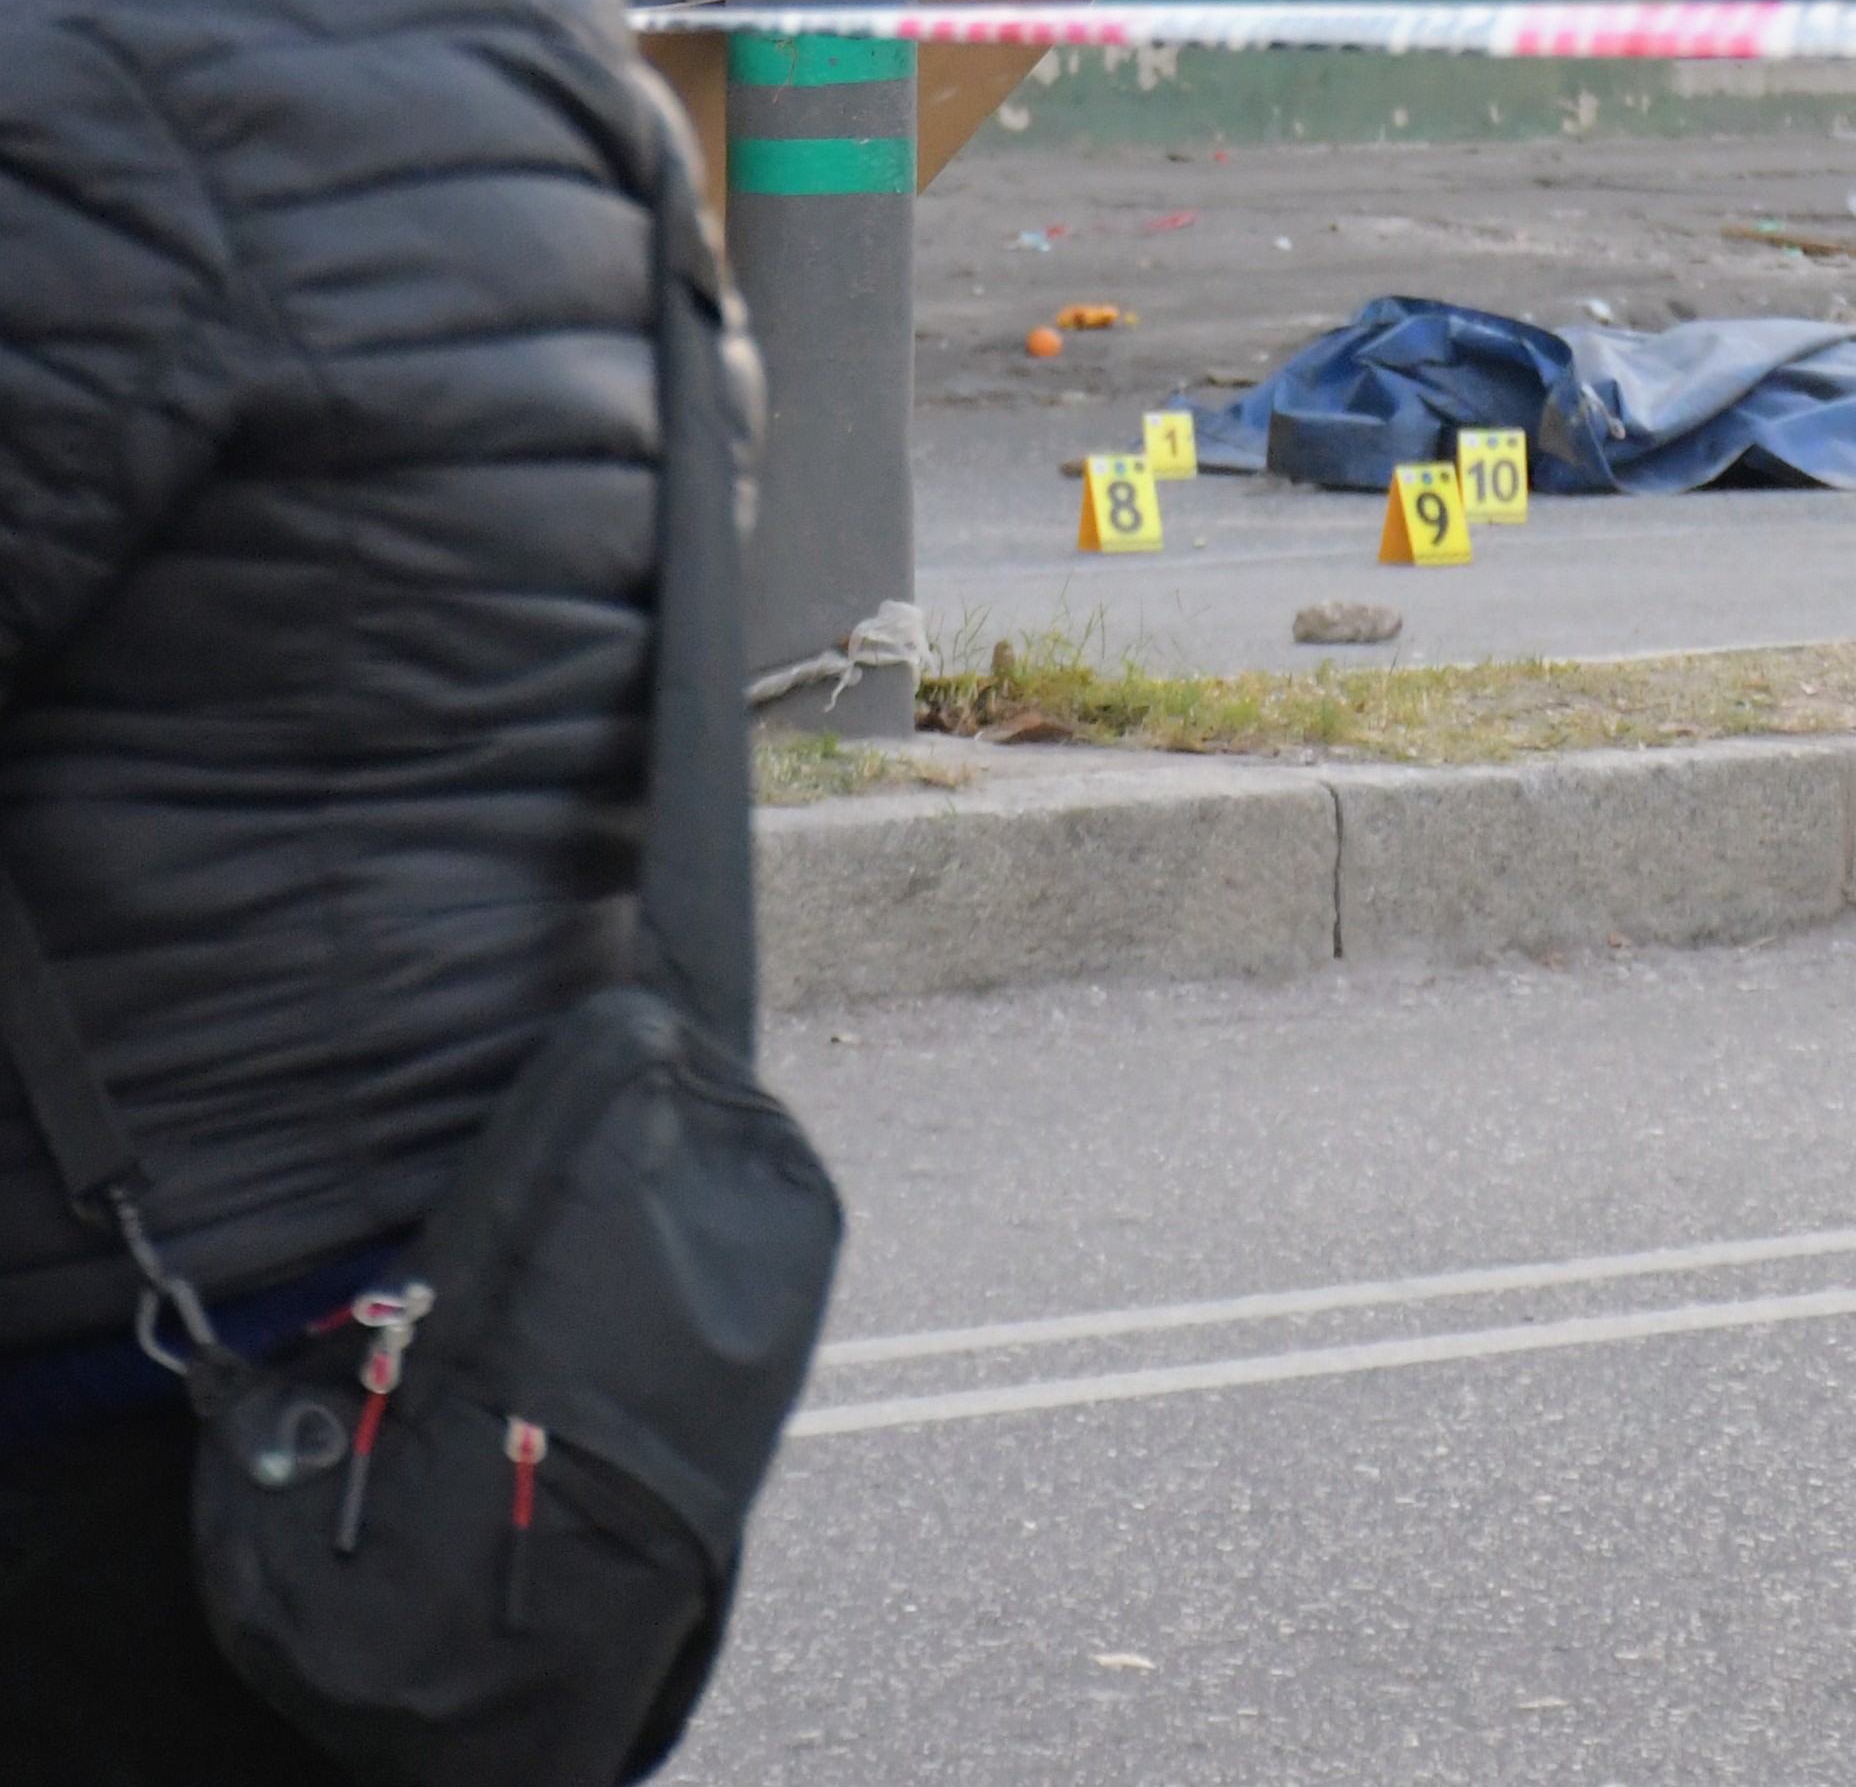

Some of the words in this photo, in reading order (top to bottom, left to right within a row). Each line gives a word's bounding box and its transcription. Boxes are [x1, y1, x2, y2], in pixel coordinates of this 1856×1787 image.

[1464, 457, 1520, 503] 10
[1107, 481, 1142, 533] 8
[1415, 490, 1449, 546] 9
